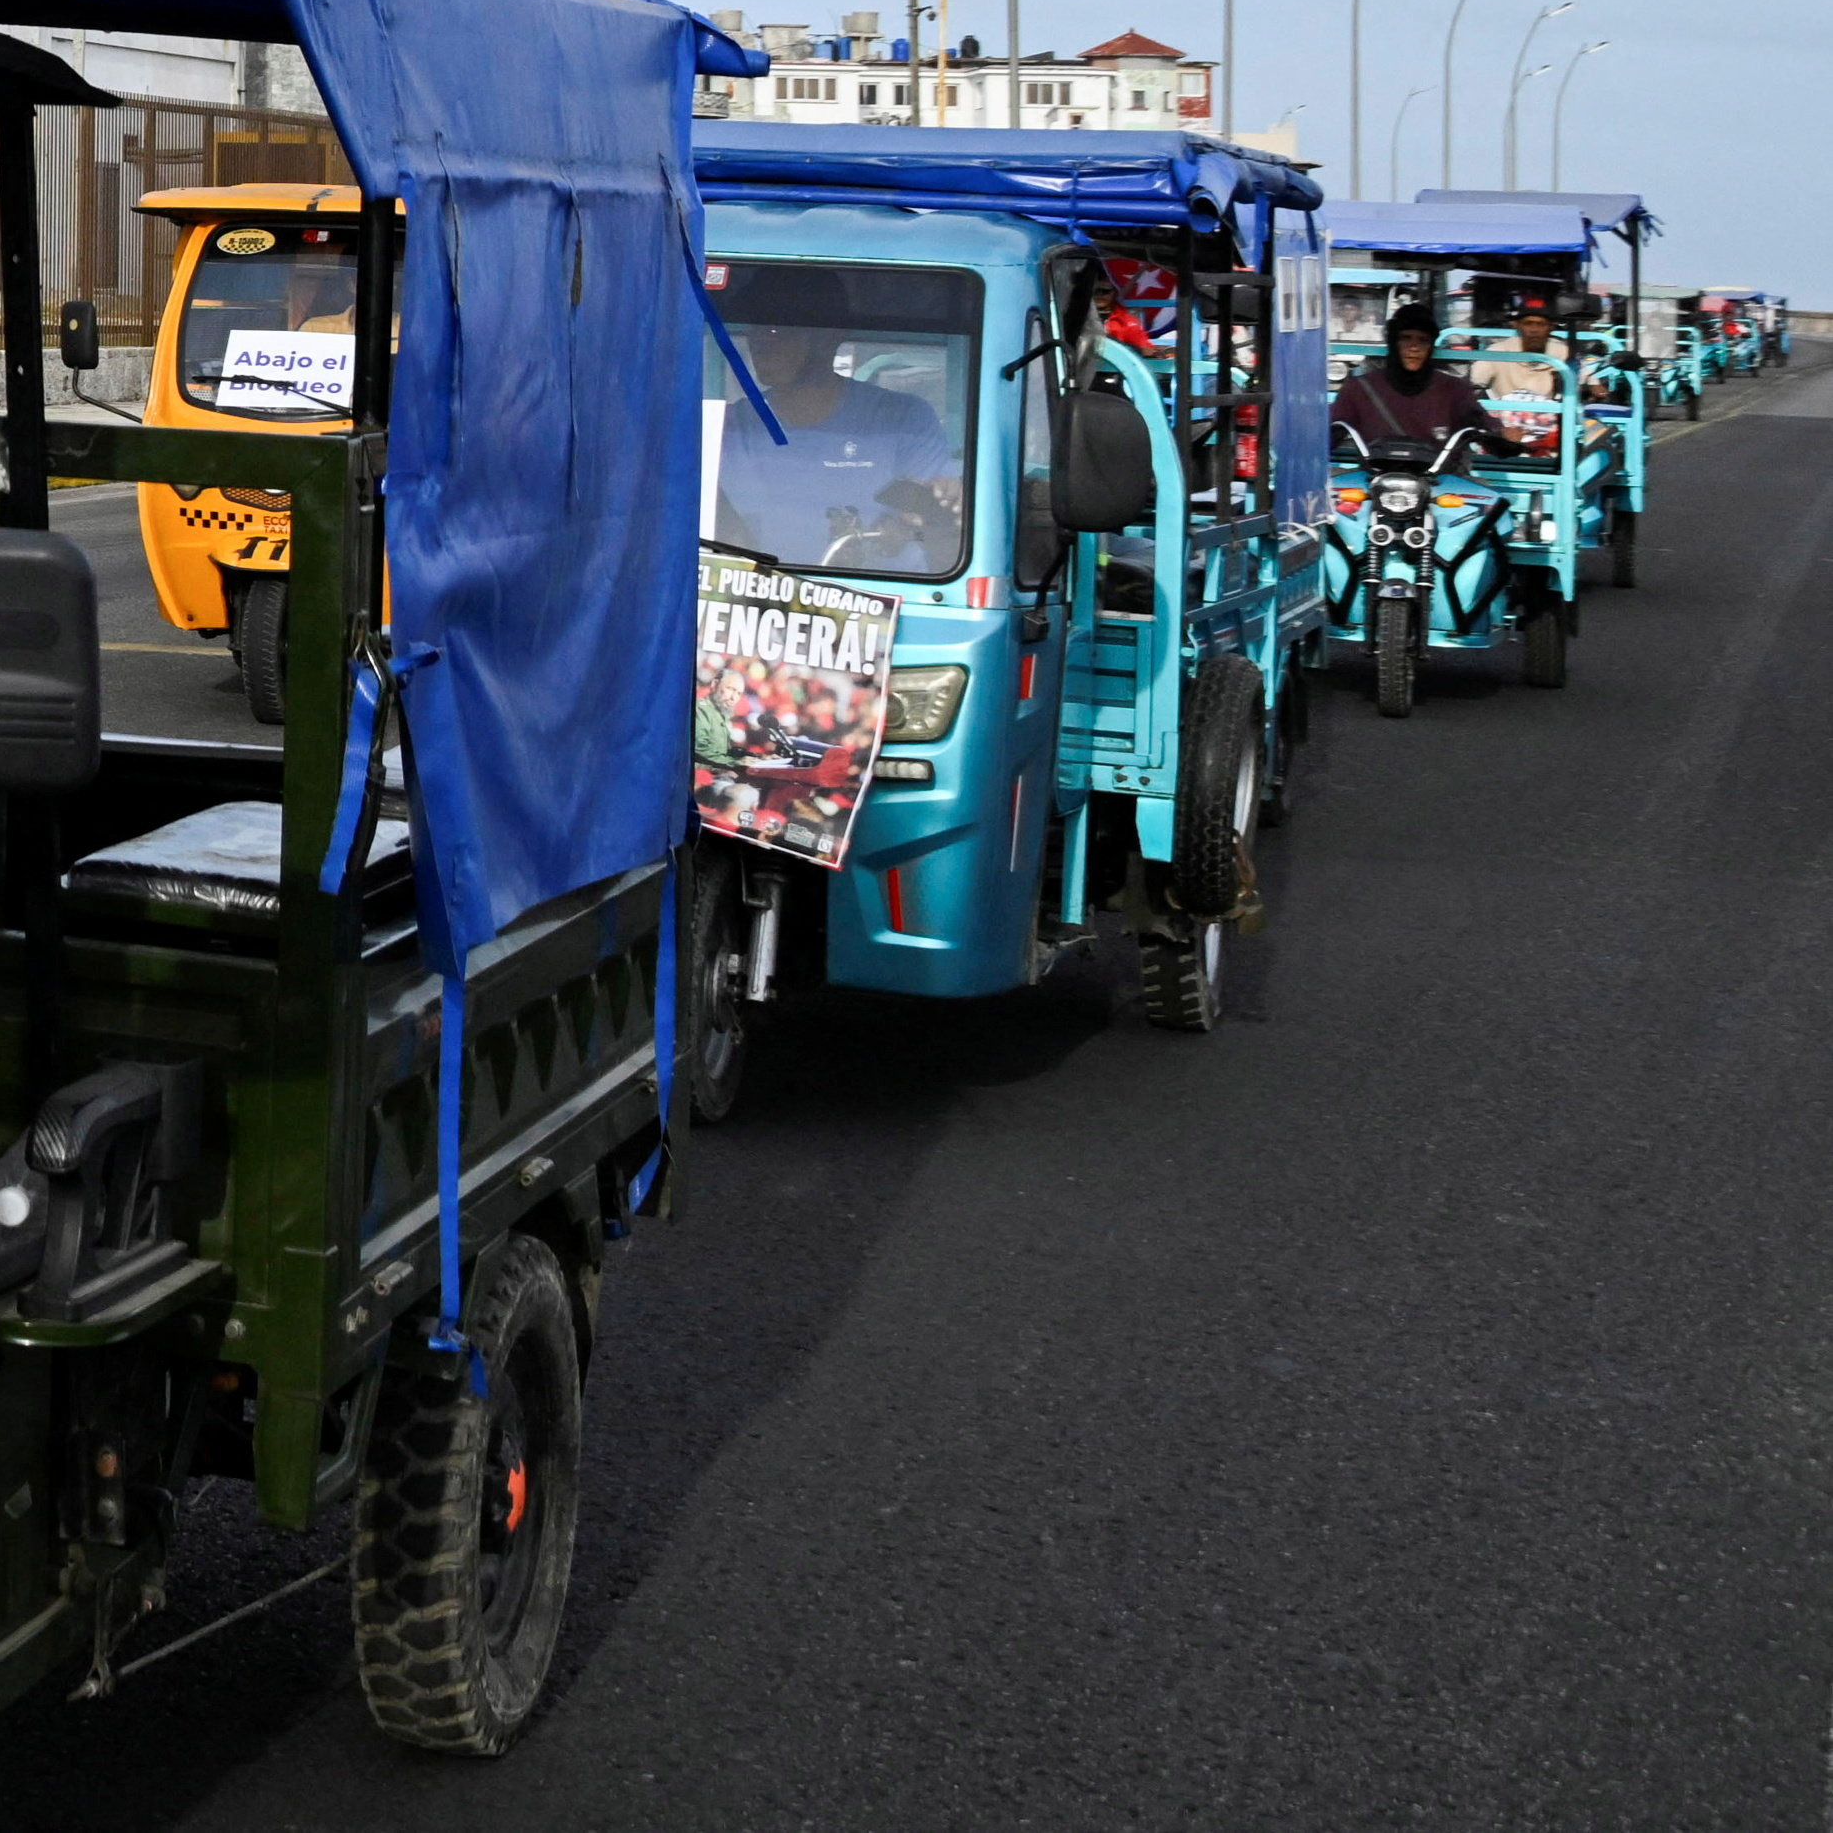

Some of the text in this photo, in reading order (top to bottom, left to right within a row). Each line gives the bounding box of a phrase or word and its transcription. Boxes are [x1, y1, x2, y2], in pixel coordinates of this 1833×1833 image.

[234, 350, 347, 371] Abajo el
[263, 515, 288, 527] ECO
[718, 568, 795, 603] PUEBLO
[799, 581, 884, 616] CUBANO
